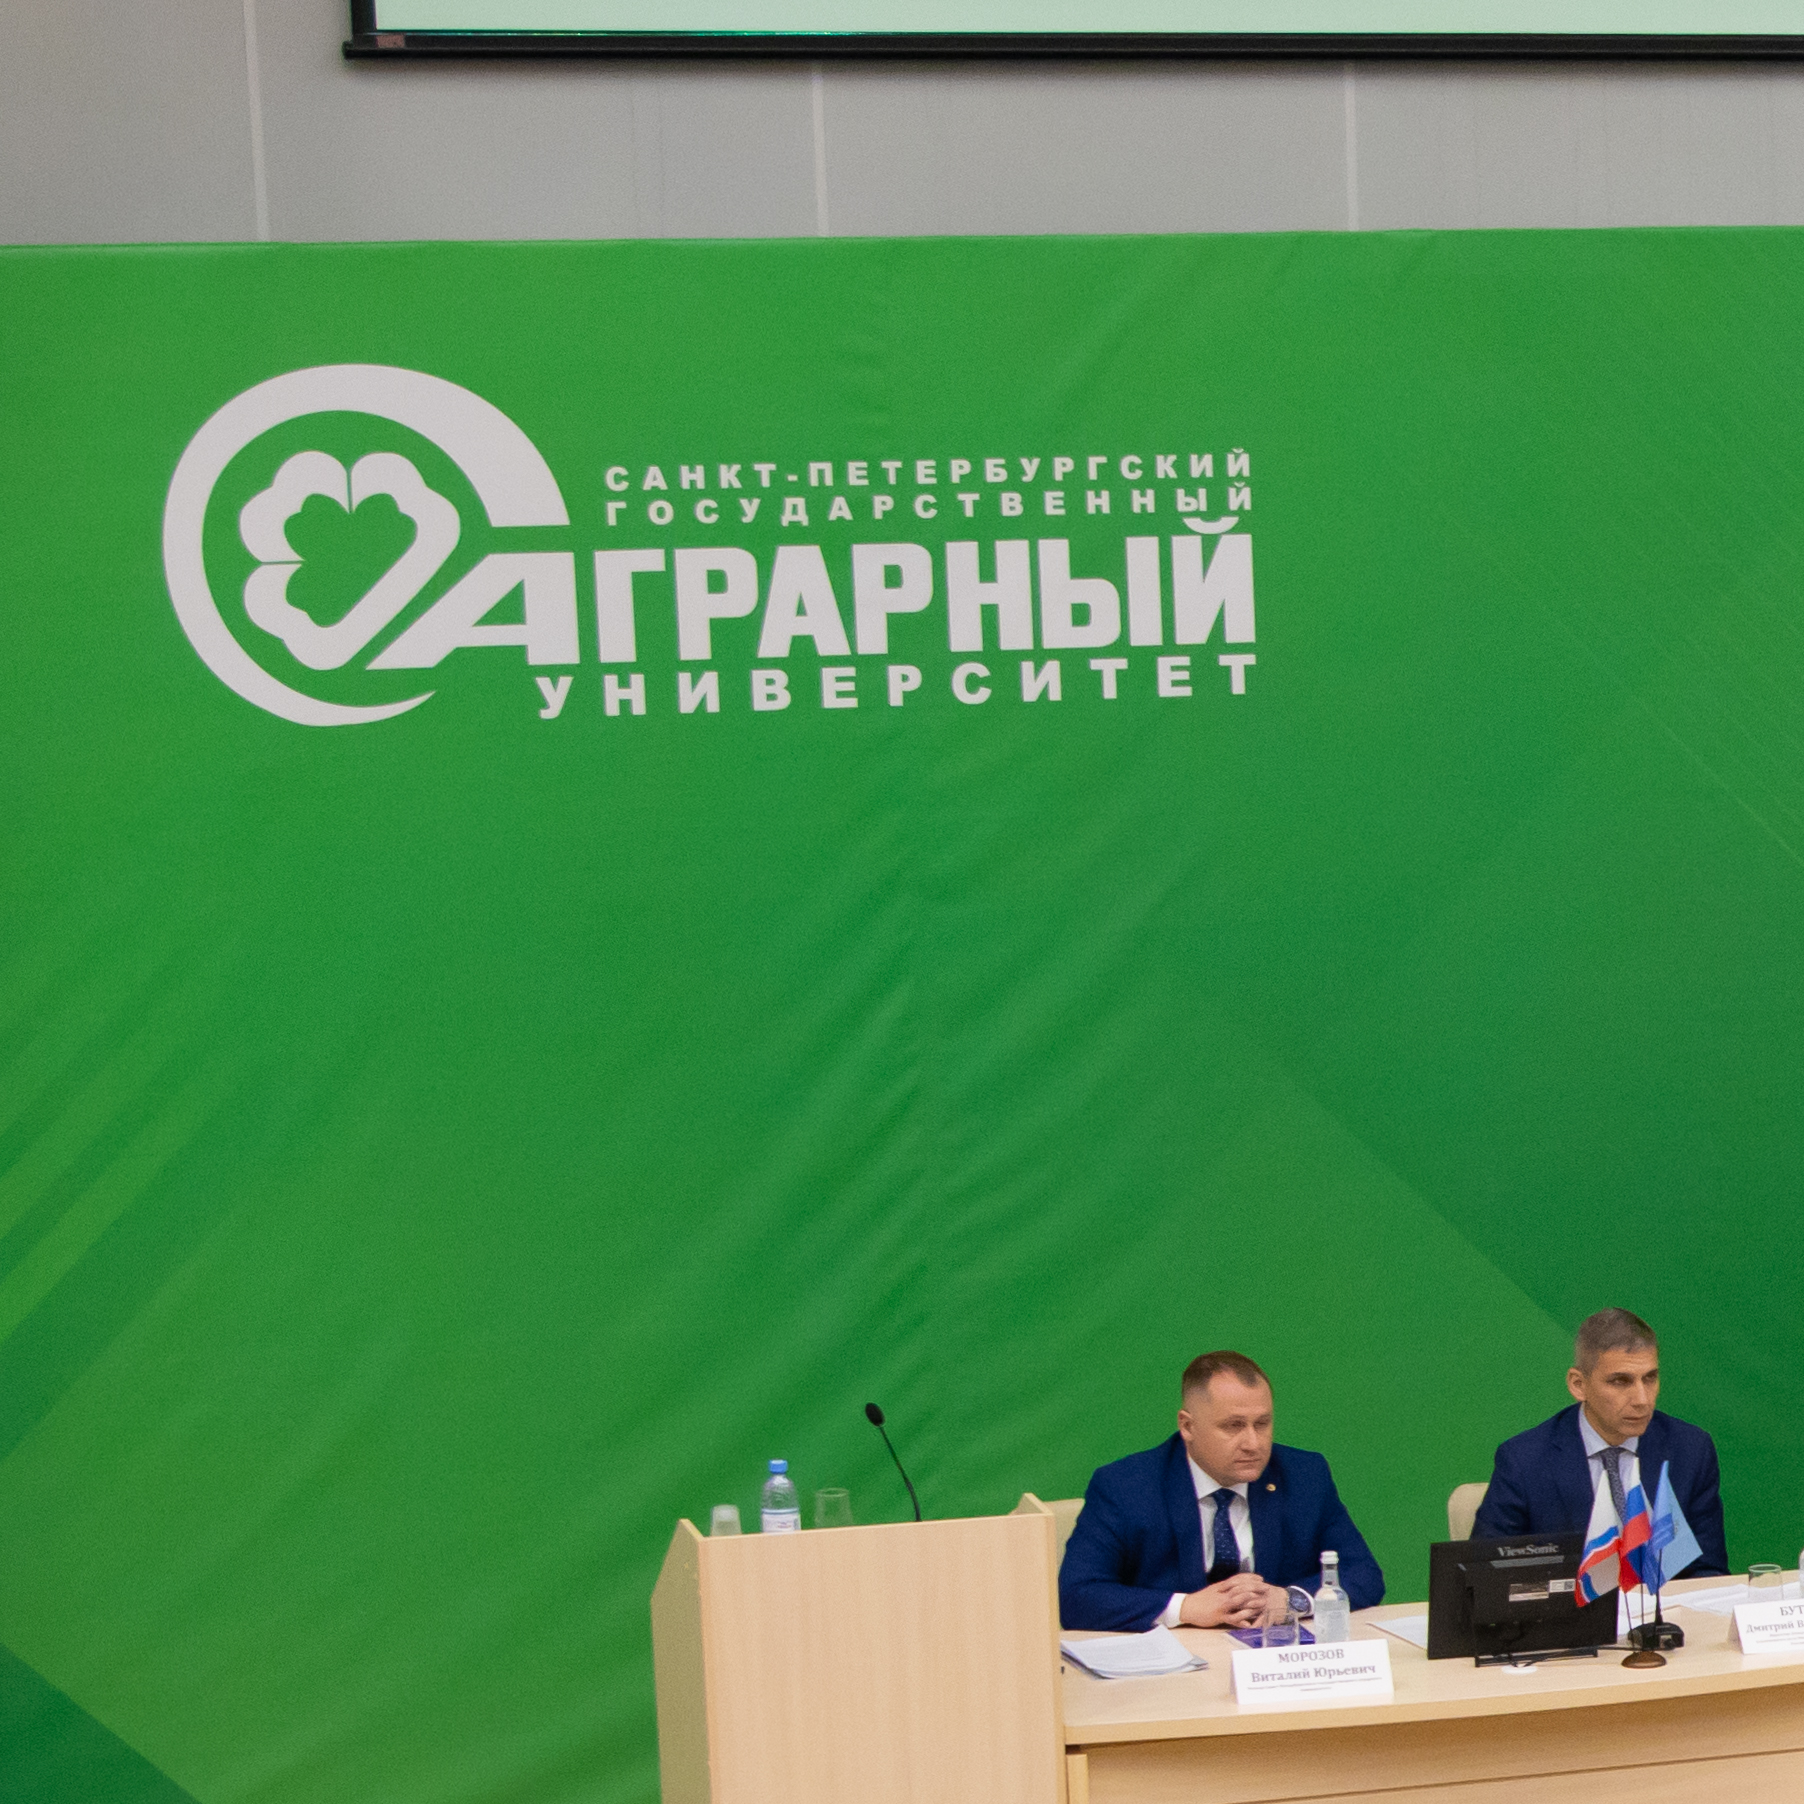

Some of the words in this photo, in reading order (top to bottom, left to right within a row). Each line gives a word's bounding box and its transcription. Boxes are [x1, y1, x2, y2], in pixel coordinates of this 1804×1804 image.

[604, 447, 1252, 492] САНКТ-ПЕТЕРБУРГСКИЙ
[605, 482, 1253, 527] ГОСУДАРСТВЕННЫЙ
[366, 516, 1257, 671] АГРАРНЫЙ
[535, 653, 1258, 720] УНИВЕРСИТЕТ
[1746, 1619, 1795, 1635] Дмитрий
[1251, 1668, 1311, 1684] Виталий
[1314, 1664, 1377, 1681] Юрьевич
[1278, 1648, 1345, 1664] МОРОЗОВ
